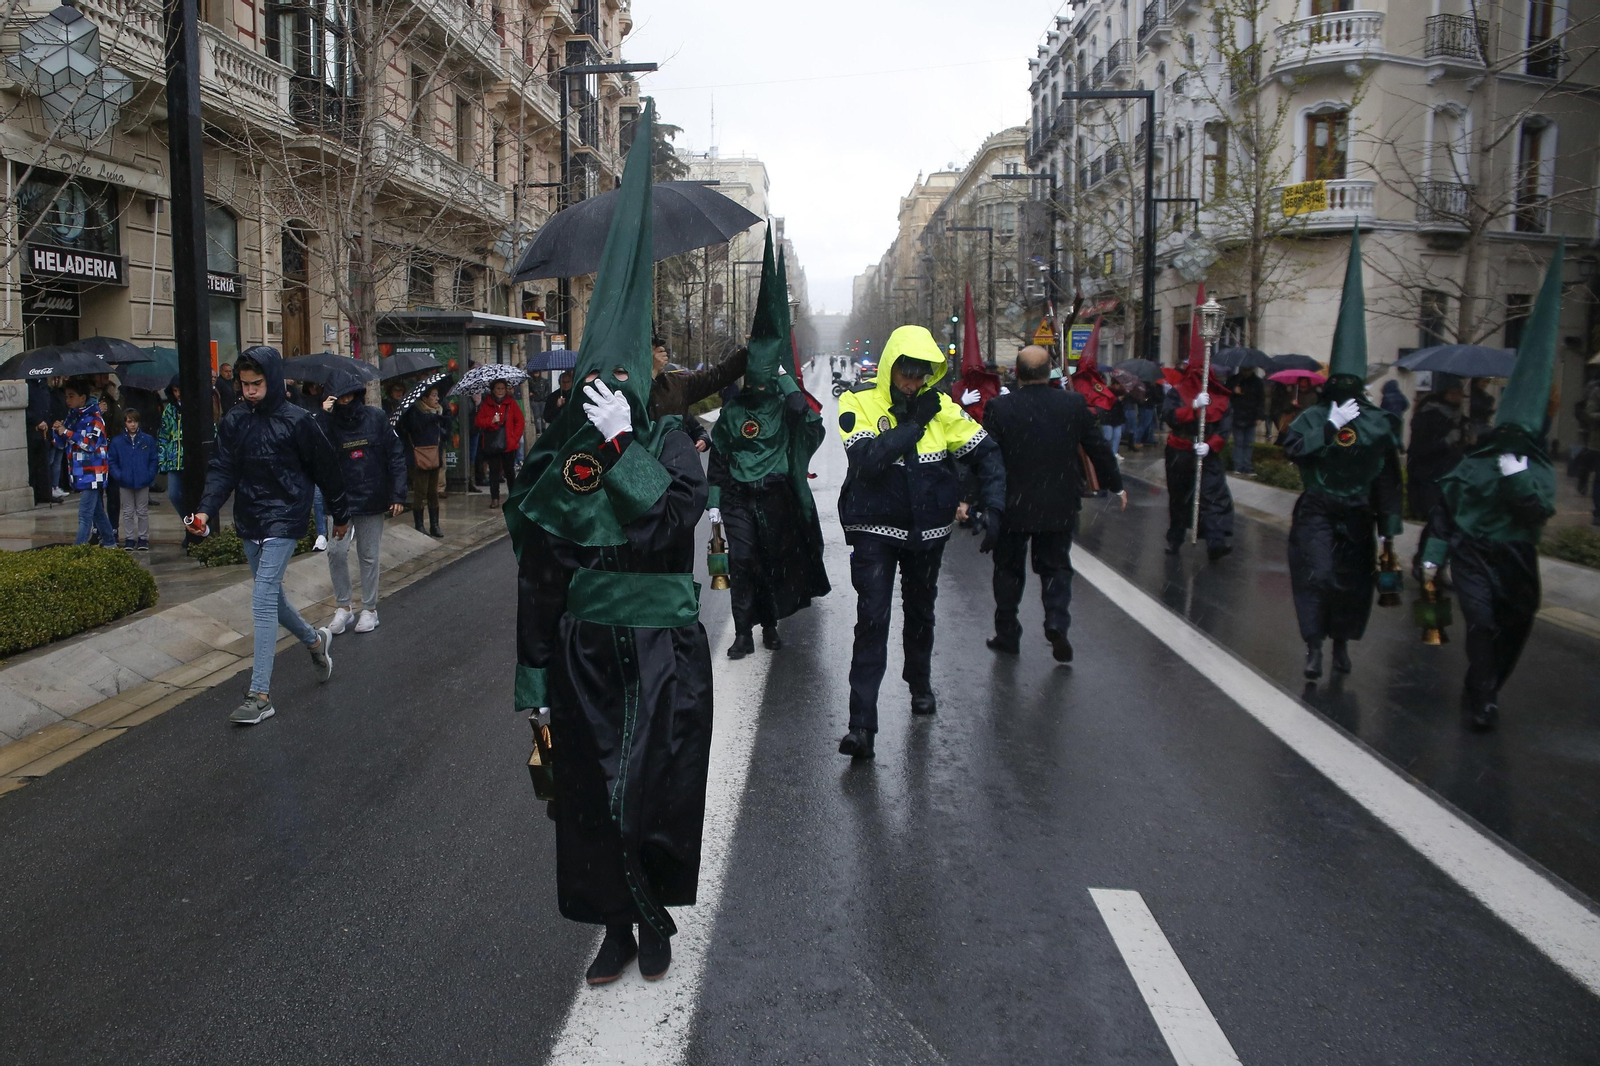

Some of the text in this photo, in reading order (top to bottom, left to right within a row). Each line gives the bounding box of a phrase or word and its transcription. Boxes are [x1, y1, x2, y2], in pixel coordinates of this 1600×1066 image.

[60, 153, 126, 183] Dolce Luna
[1286, 187, 1294, 197] SE
[34, 250, 117, 279] HELADERIA
[31, 286, 74, 310] Luna
